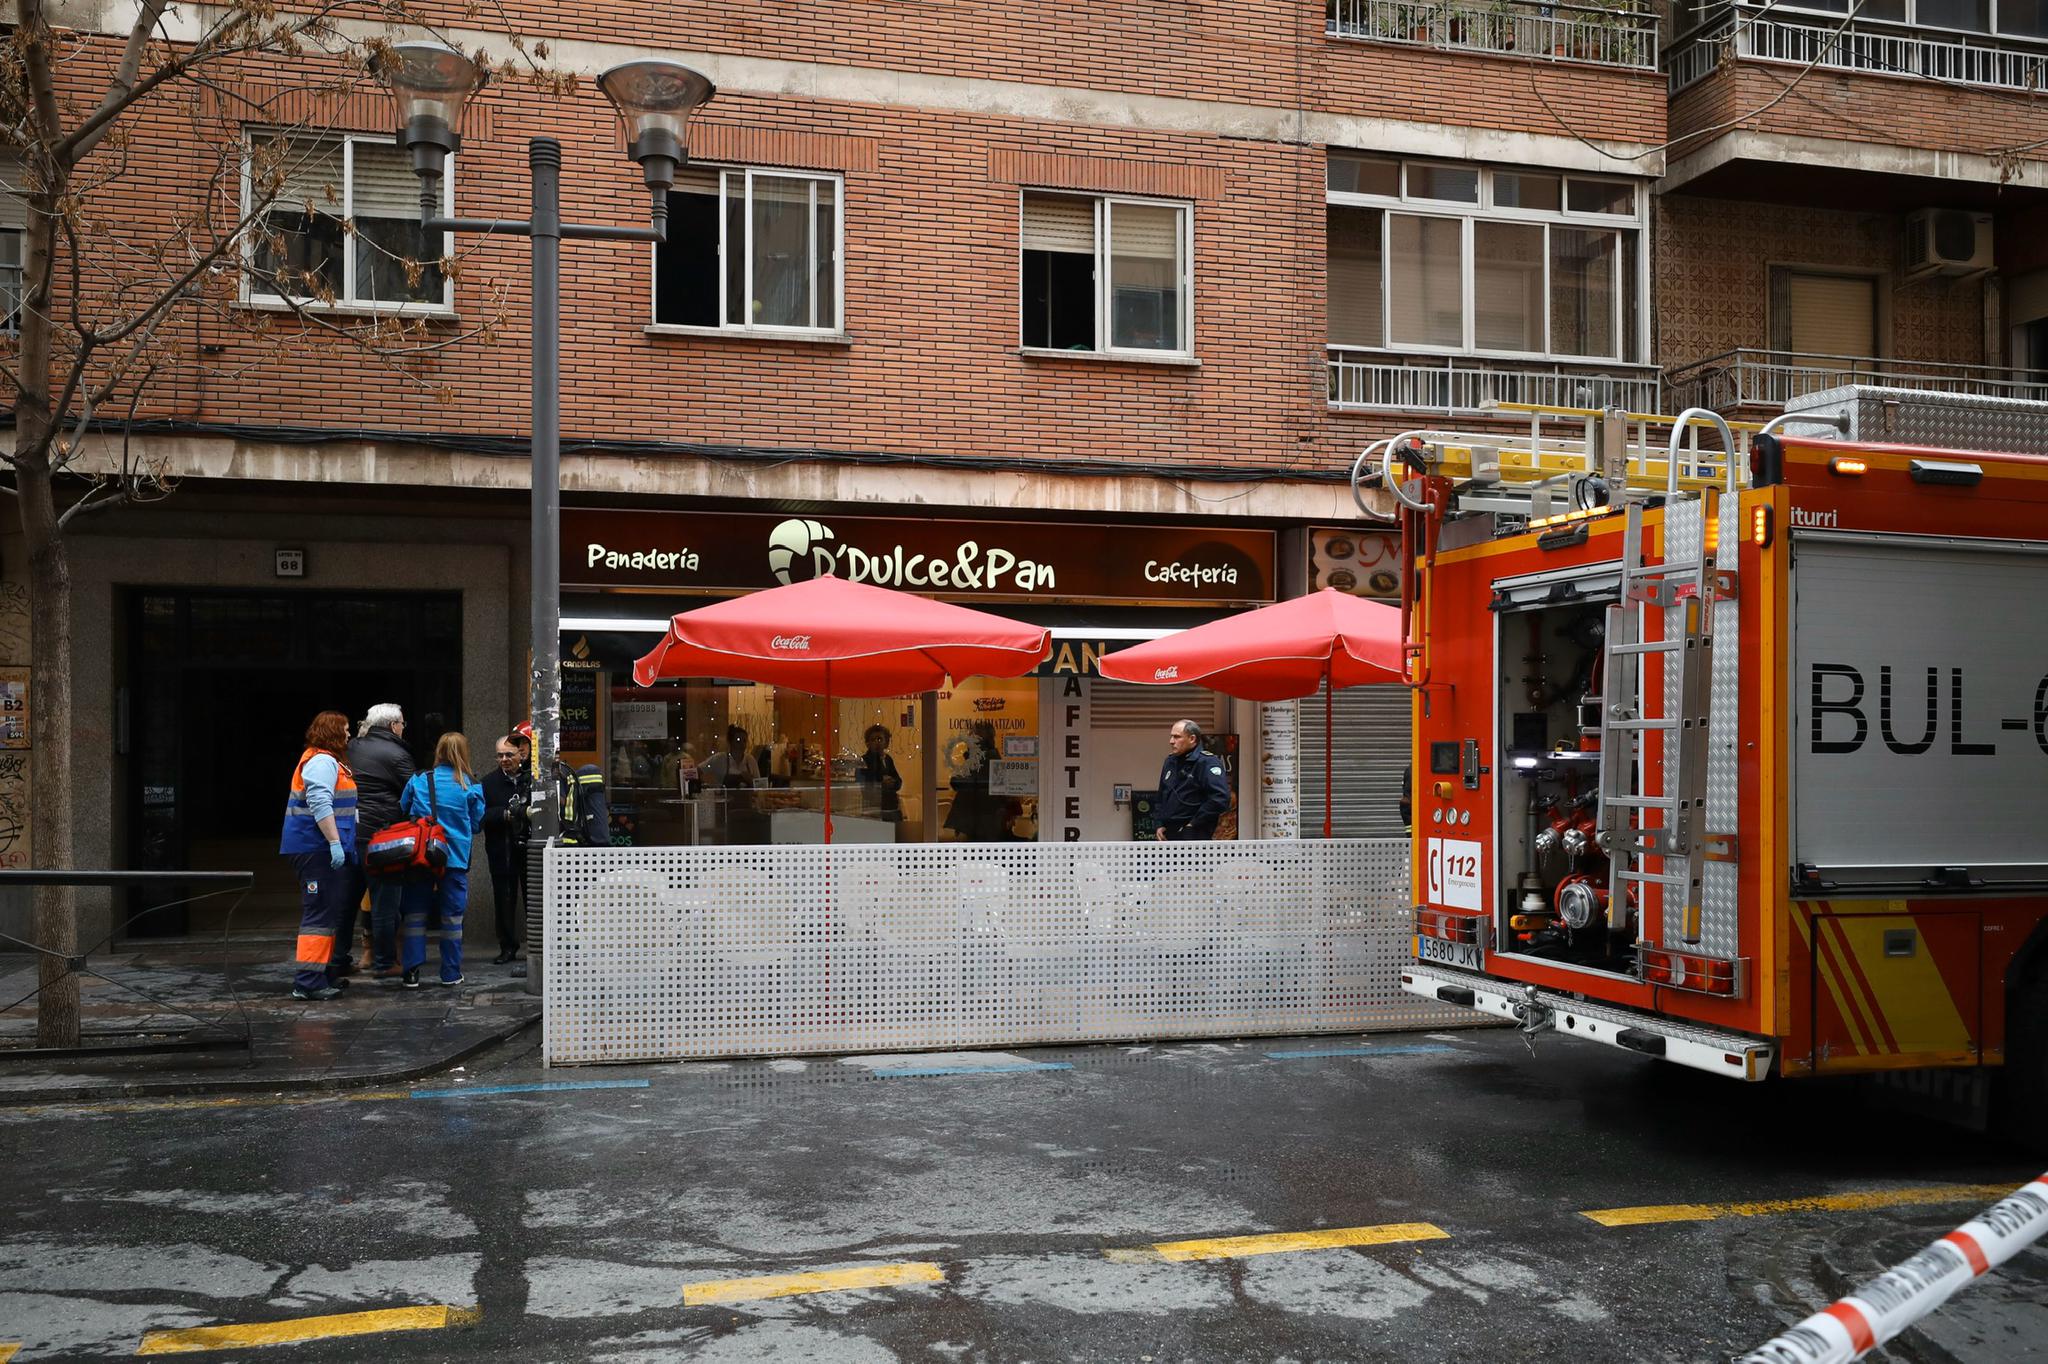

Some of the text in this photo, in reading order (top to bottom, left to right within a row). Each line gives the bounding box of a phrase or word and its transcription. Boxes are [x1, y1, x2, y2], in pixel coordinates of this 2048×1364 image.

[1790, 506, 1837, 527] iturri
[281, 560, 298, 570] 68
[587, 543, 699, 571] Panadería
[1144, 560, 1238, 588] Cafetería
[771, 635, 811, 650] Coca-Cola
[562, 660, 600, 668] CANDELAS
[1154, 665, 1178, 680] Coca-Cola
[1811, 663, 2048, 755] BUL-
[949, 718, 1025, 730] LOCAL CLIMATIZADO
[1447, 854, 1476, 878] 112
[1448, 877, 1476, 888] Emergencias
[1425, 939, 1454, 962] 5680
